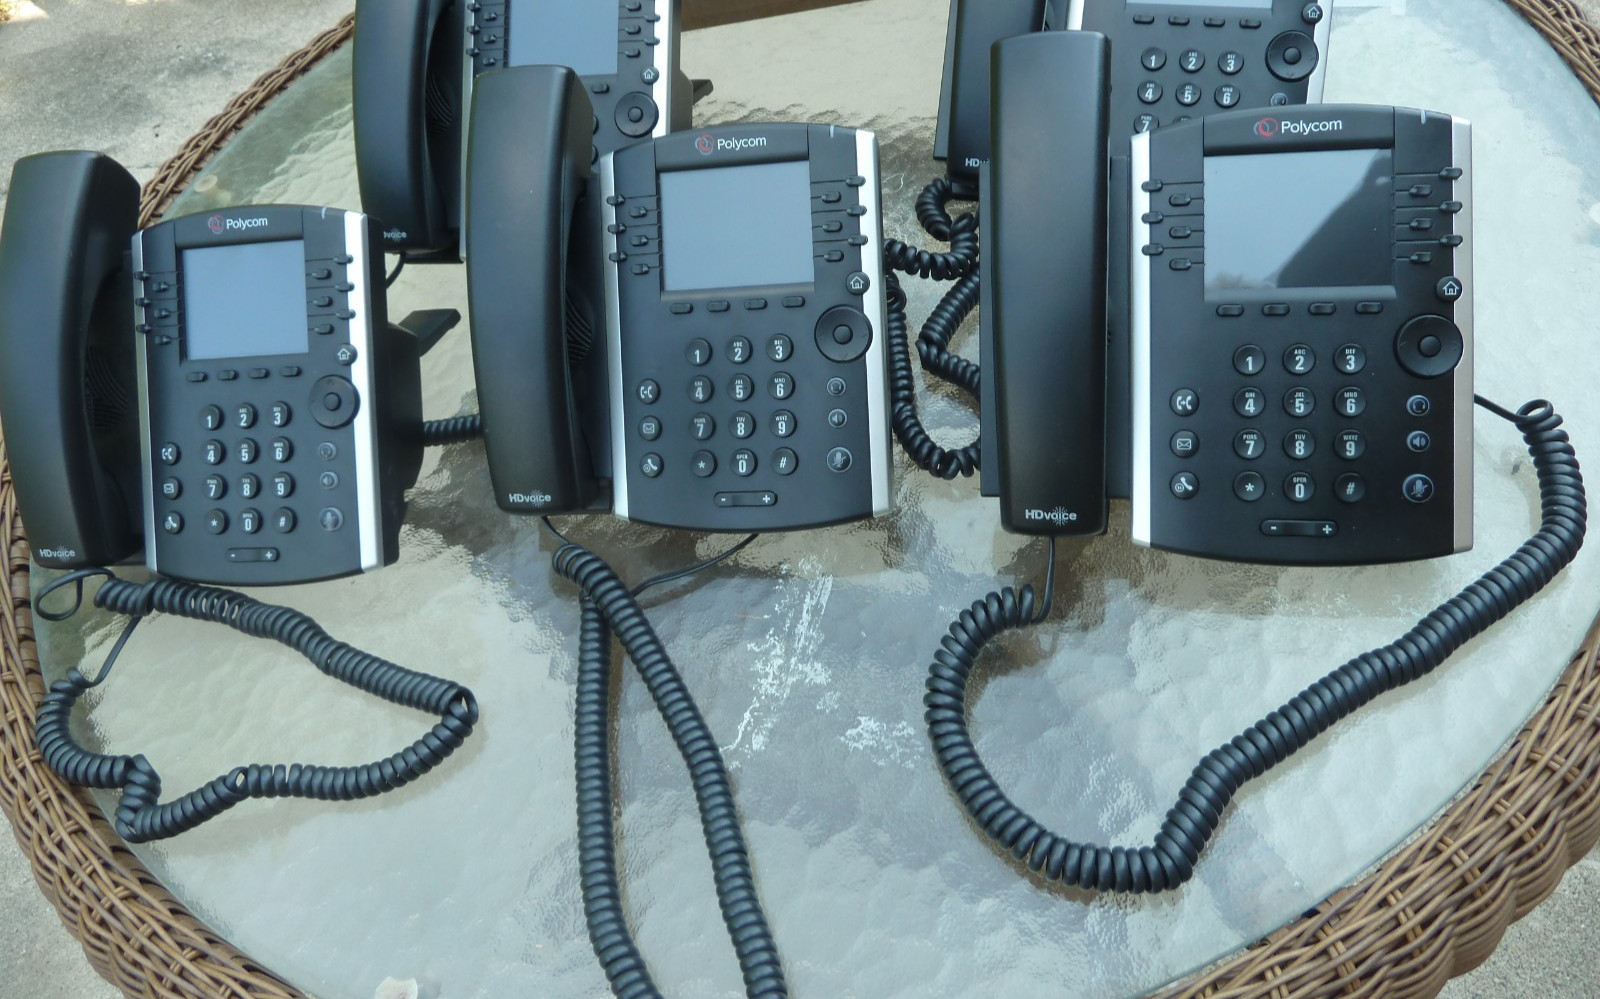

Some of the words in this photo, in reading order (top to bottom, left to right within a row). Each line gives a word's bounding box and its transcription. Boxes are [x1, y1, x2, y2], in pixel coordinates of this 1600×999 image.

[1150, 55, 1156, 68] 1
[1188, 58, 1196, 69] 2
[1227, 59, 1235, 71] 3
[1145, 88, 1153, 100] 4
[1184, 90, 1192, 102] 5
[1223, 93, 1231, 104] 6
[1142, 120, 1150, 132] 7
[1281, 120, 1342, 135] Polycom
[718, 137, 767, 151] Polycom
[226, 217, 268, 230] Polycom
[695, 349, 700, 363] 1
[734, 348, 742, 361] 2
[775, 345, 783, 359] 3
[1246, 356, 1253, 371] 1
[1295, 356, 1304, 370] 2
[1346, 355, 1355, 370] 3
[695, 386, 703, 400] 4
[736, 385, 743, 398] 5
[776, 383, 784, 397] 6
[1245, 398, 1255, 413] 4
[1295, 399, 1304, 413] 5
[1346, 399, 1356, 414] 6
[207, 415, 212, 428] 1
[240, 413, 247, 426] 2
[274, 412, 281, 425] 3
[697, 423, 704, 438] 7
[737, 422, 745, 436] 8
[778, 422, 786, 435] 9
[275, 448, 283, 460] 6
[1246, 441, 1255, 455] 7
[1295, 440, 1305, 455] 8
[1346, 441, 1355, 456] 9
[208, 450, 215, 463] 4
[241, 449, 249, 462] 5
[780, 456, 787, 468] #
[738, 460, 747, 473] 0
[209, 484, 216, 497] 7
[244, 483, 250, 496] 8
[277, 483, 284, 496] 9
[1295, 484, 1304, 498] 0
[1346, 482, 1356, 495] #
[509, 493, 552, 503] HDvoice
[1025, 509, 1077, 521] HDvoice
[245, 518, 252, 531] 0
[40, 549, 76, 558] HDvoice
